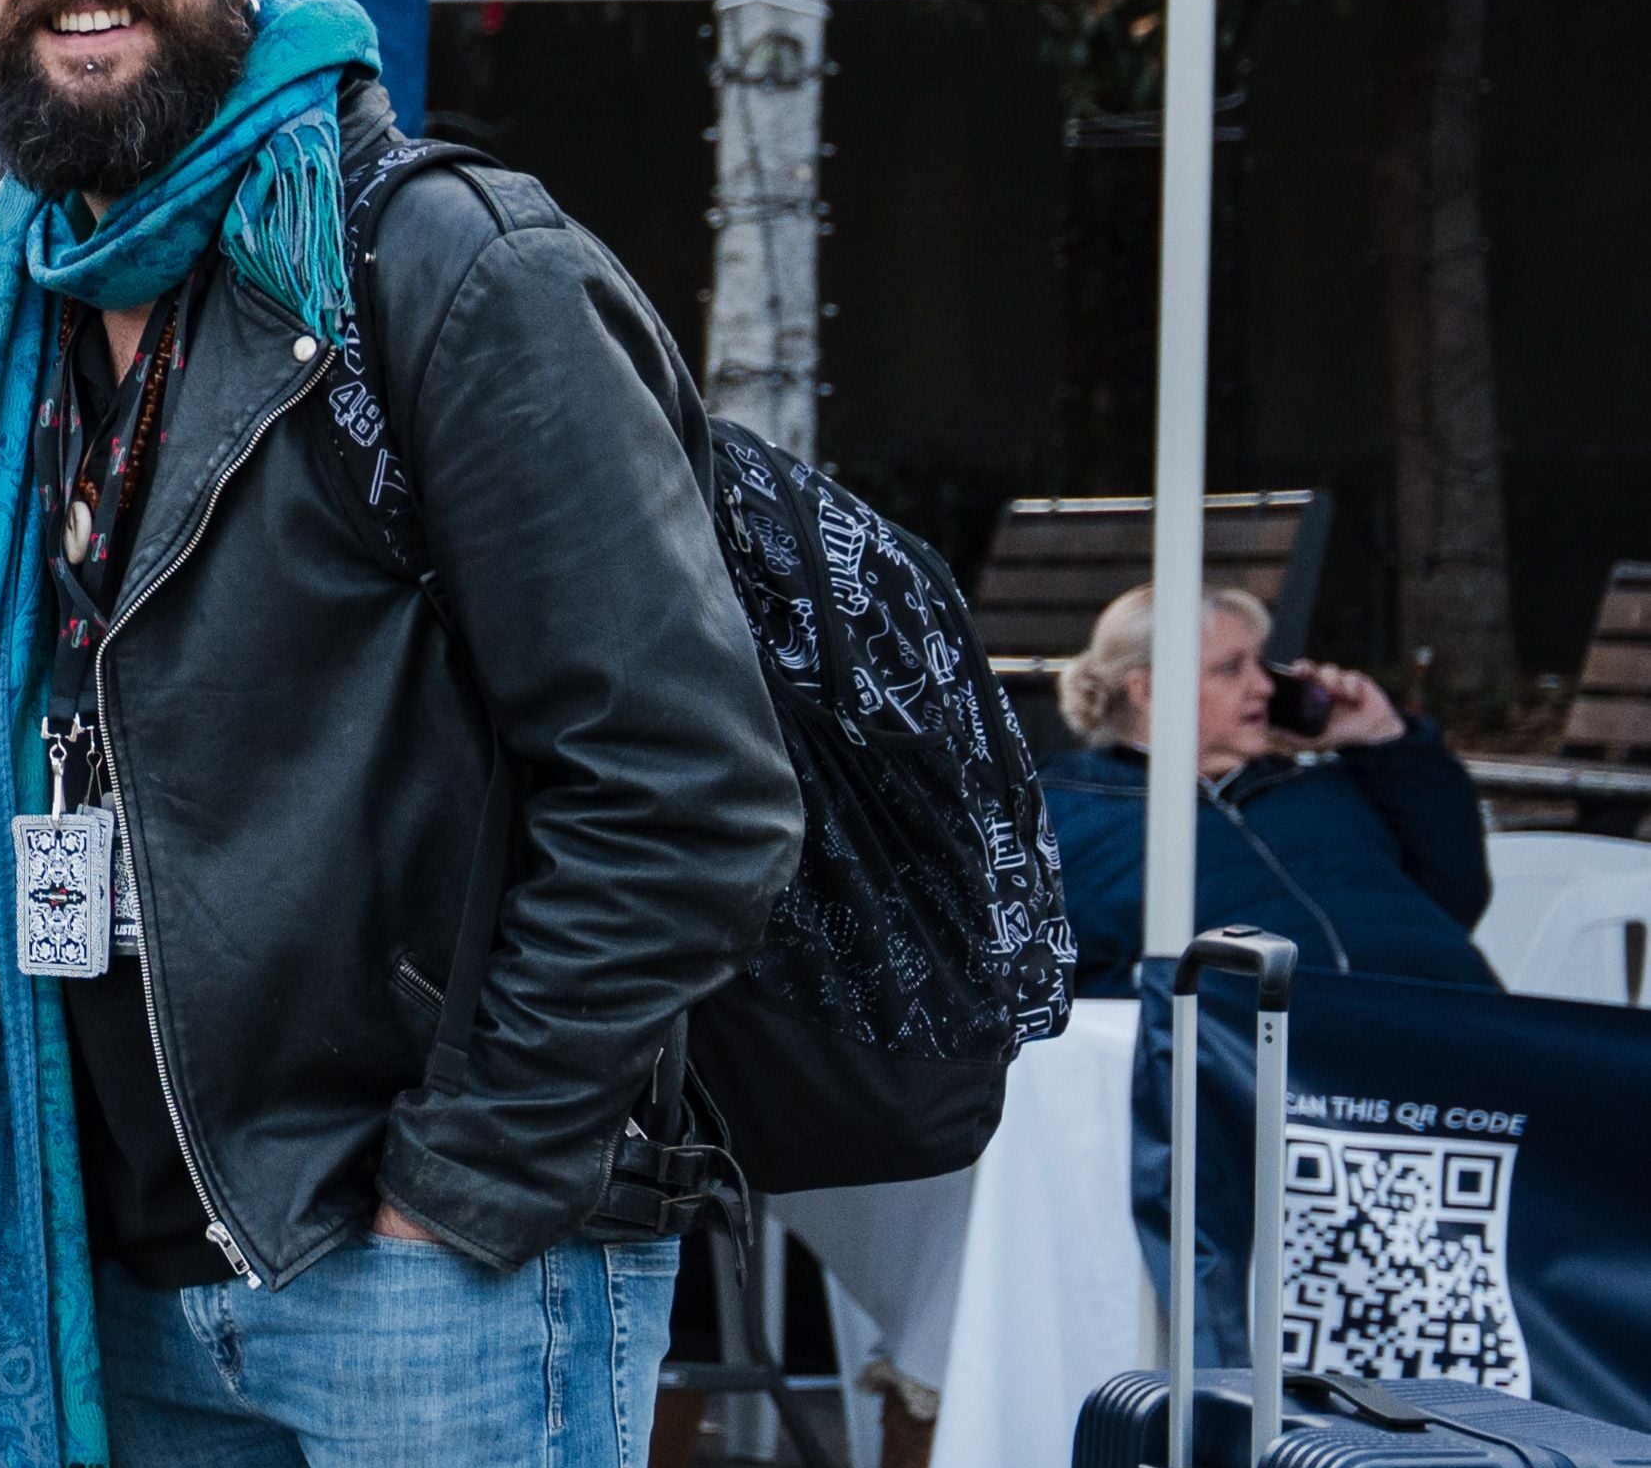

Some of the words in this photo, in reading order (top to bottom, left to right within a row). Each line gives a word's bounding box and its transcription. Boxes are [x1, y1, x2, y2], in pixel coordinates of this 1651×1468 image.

[1331, 1095, 1390, 1124] THIS
[1394, 1101, 1439, 1132] QR
[1444, 1106, 1529, 1137] CODE
